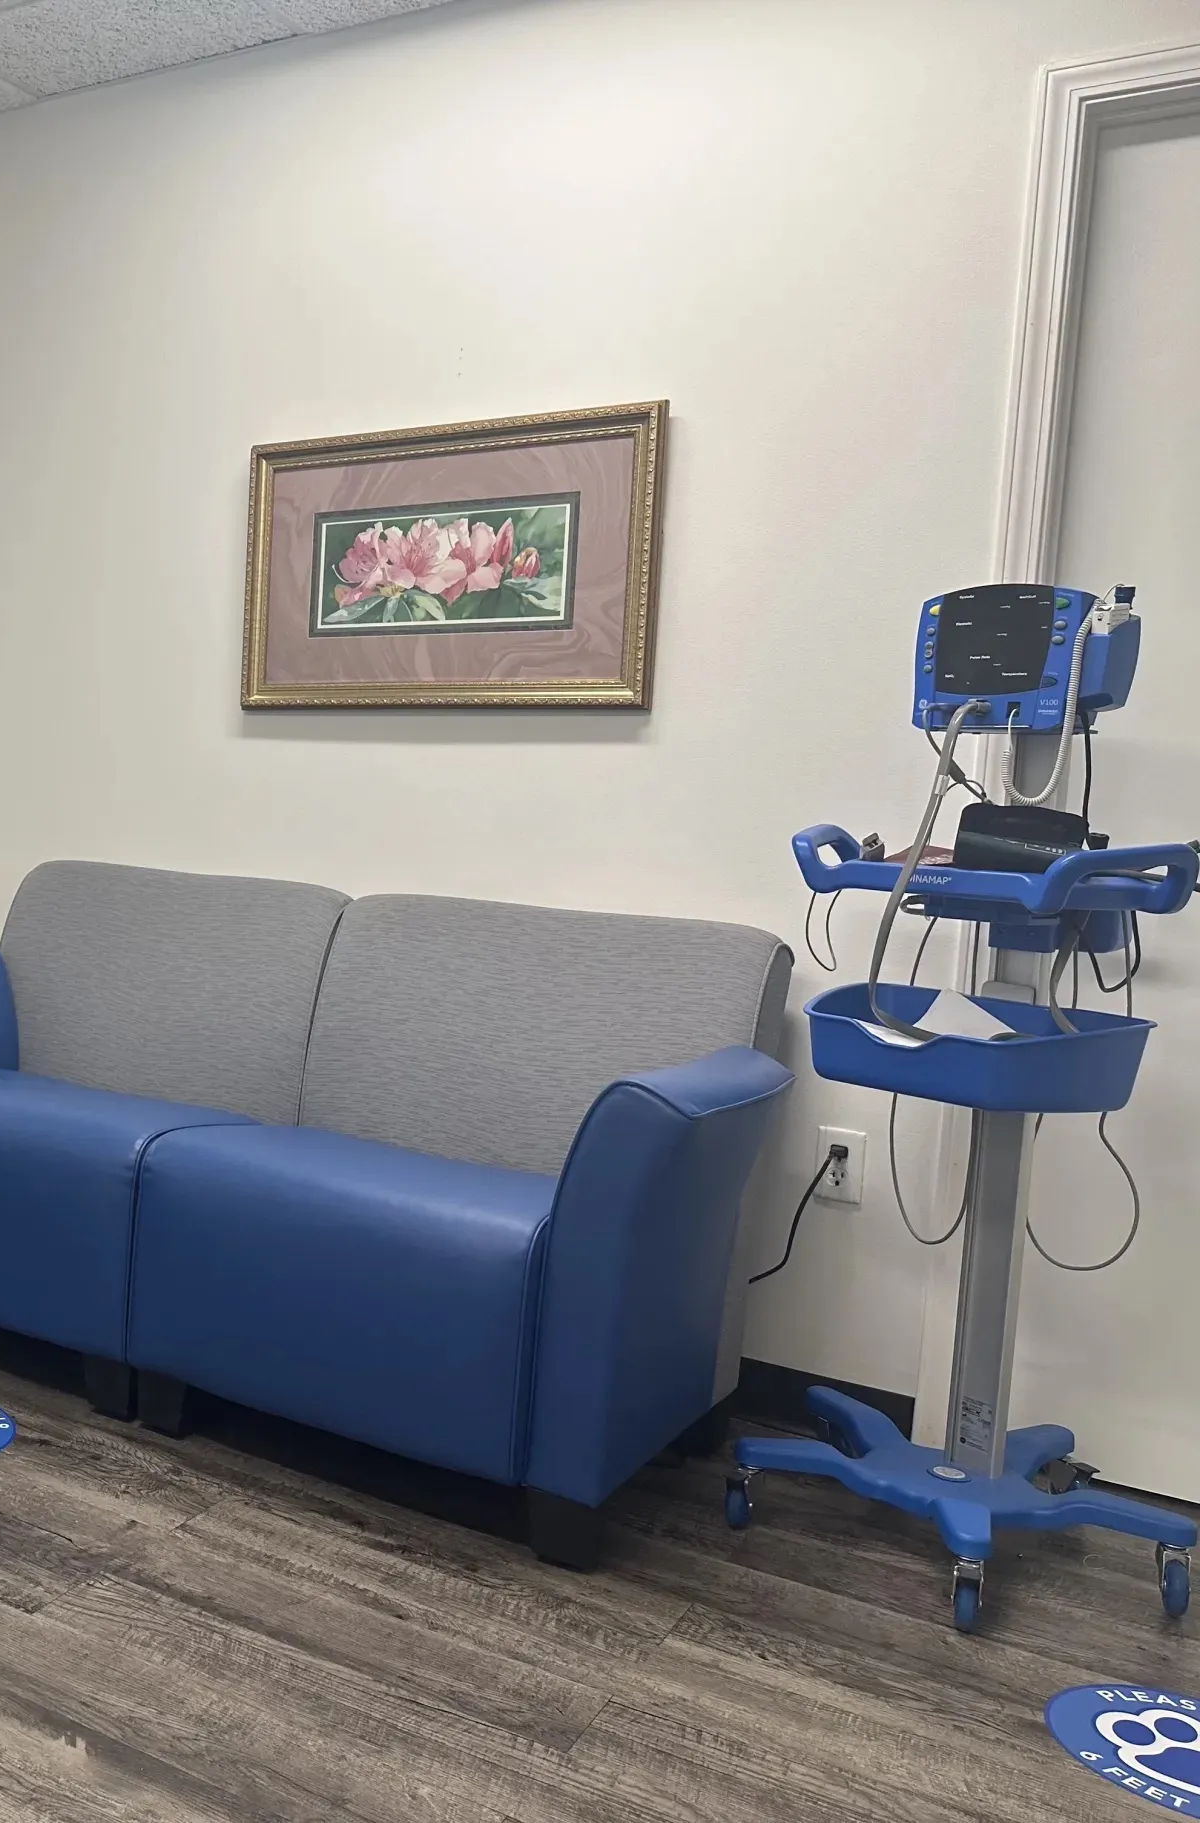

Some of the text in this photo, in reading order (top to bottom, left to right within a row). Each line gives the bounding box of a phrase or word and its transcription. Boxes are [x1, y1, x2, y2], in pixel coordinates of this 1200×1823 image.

[1040, 698, 1059, 706] V100
[910, 873, 949, 885] INAMAP
[1095, 1689, 1198, 1711] PLEAS
[1079, 1751, 1191, 1808] 6 FEET
